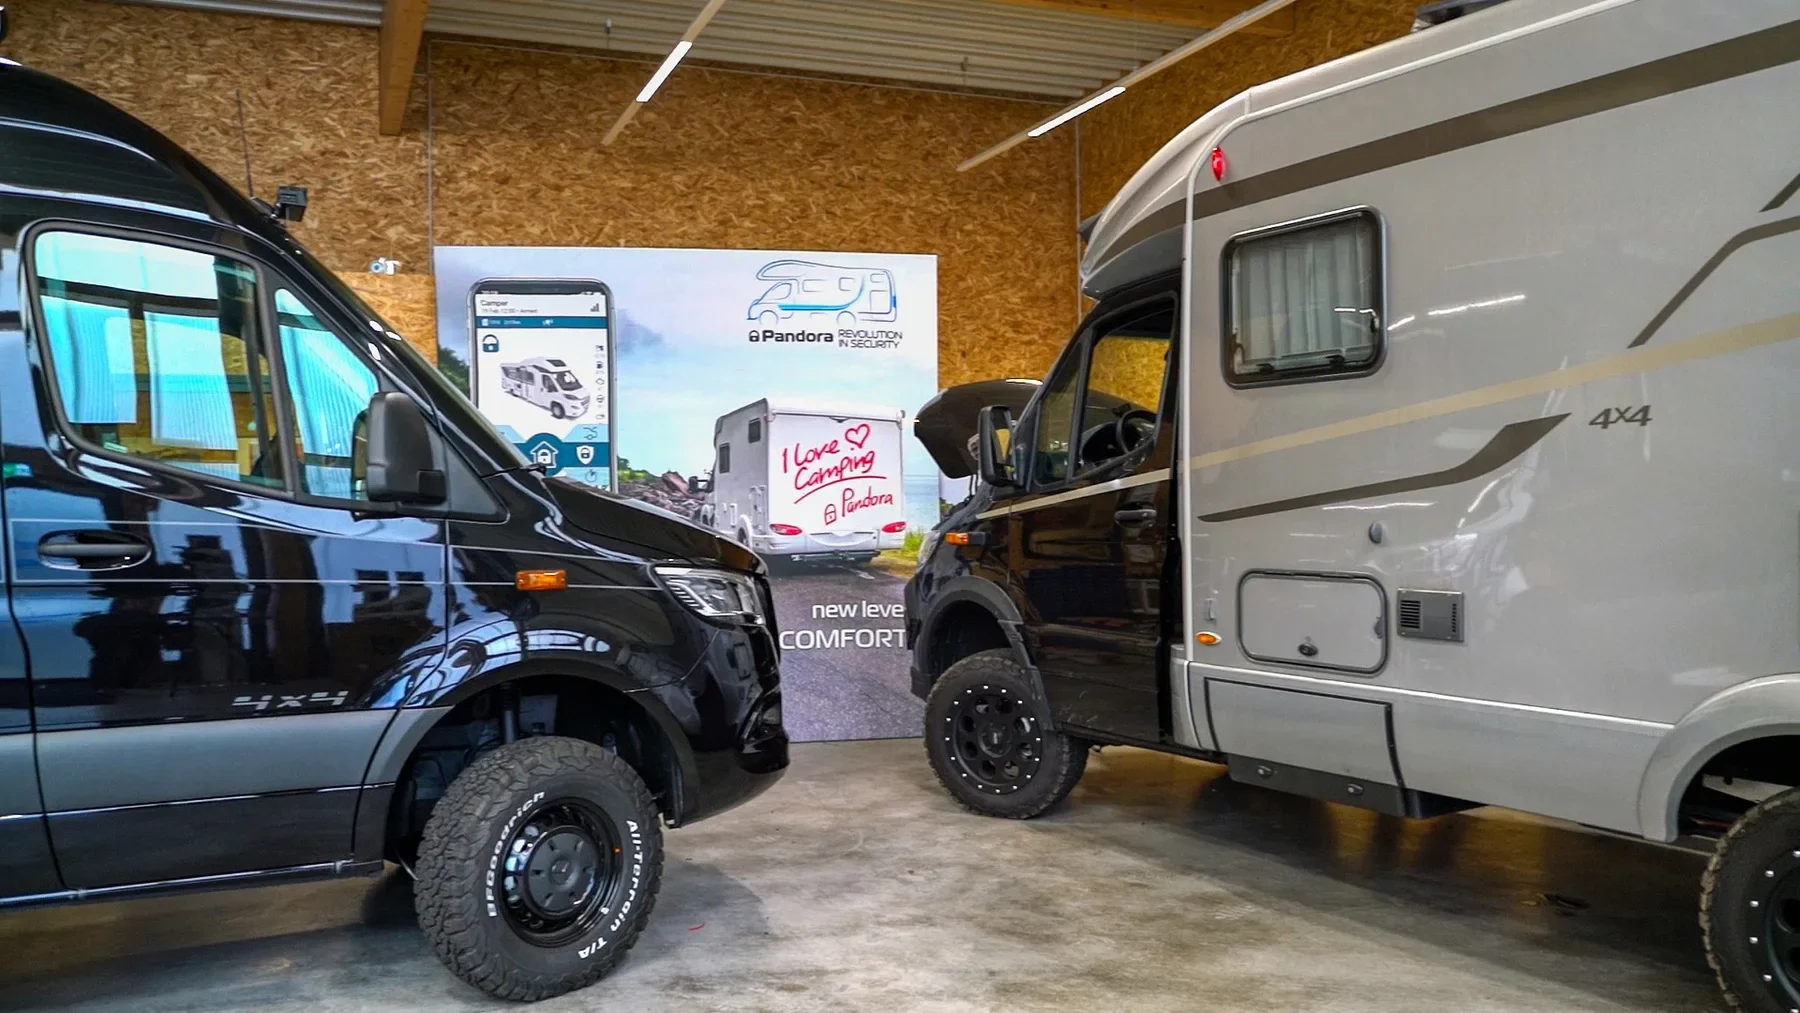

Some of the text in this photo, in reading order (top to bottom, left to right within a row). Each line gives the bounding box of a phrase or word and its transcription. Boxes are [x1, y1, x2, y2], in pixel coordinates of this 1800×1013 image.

[480, 299, 508, 307] Camper
[761, 329, 834, 342] Pandora
[838, 329, 903, 340] REVOLUTION
[838, 339, 900, 349] IN SECURITY
[782, 439, 840, 474] I Love
[794, 449, 875, 490] Camping
[841, 485, 893, 517] Pandora
[811, 603, 858, 619] new
[778, 628, 906, 650] COMFORT
[485, 791, 545, 917] BFGoodrich
[577, 936, 608, 960] T/A
